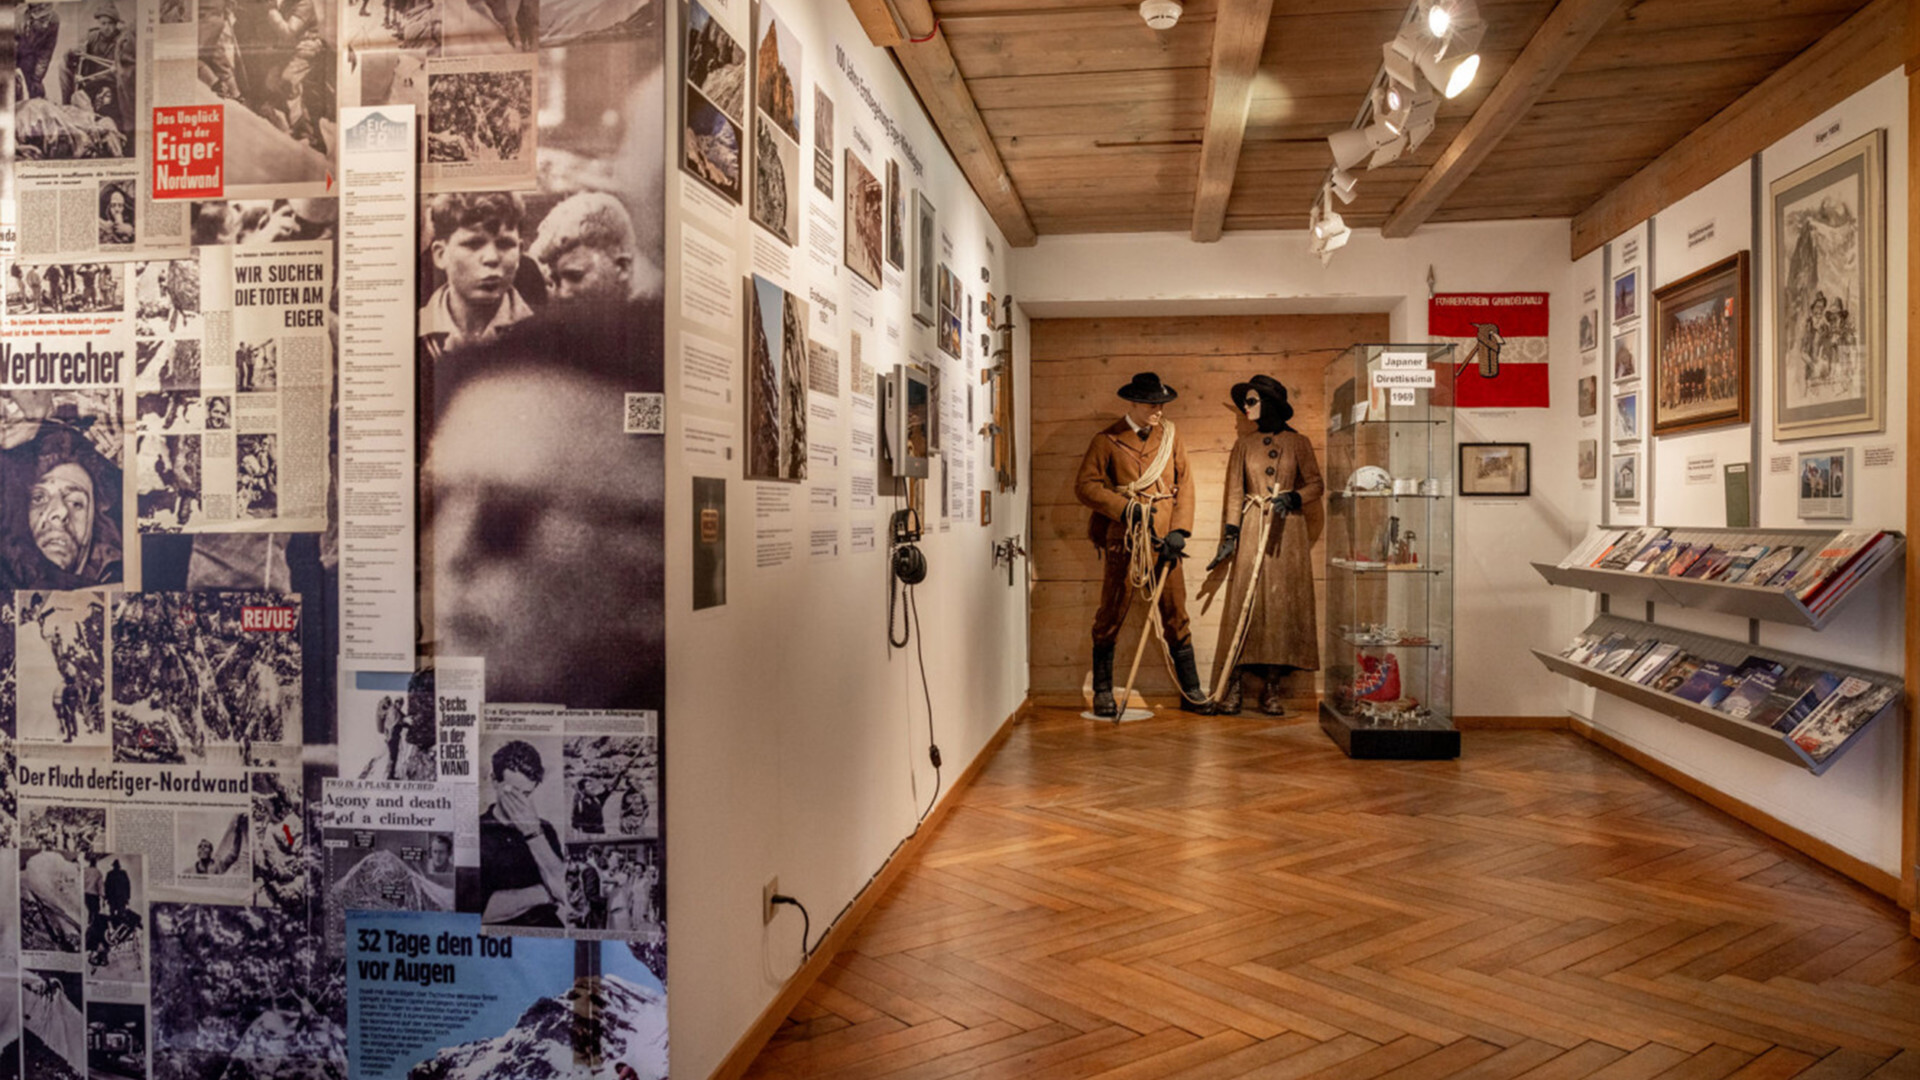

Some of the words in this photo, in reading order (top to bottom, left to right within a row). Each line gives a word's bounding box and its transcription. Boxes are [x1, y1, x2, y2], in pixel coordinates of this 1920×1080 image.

[156, 111, 175, 125] Das
[177, 109, 220, 127] Unglück
[182, 126, 193, 138] in
[194, 126, 210, 138] der
[156, 131, 220, 166] Eiger-
[156, 164, 220, 191] Nordwand
[235, 265, 262, 283] WIR
[268, 263, 324, 282] SUCHEN
[235, 288, 257, 306] DIE
[258, 287, 299, 305] TOTEN
[302, 286, 324, 304] AM
[284, 309, 324, 328] EIGER
[0, 341, 124, 385] Verbrecher
[1384, 357, 1423, 367] Japaner
[1376, 374, 1433, 383] Direttissima
[1392, 392, 1414, 401] 1969
[243, 609, 292, 629] REVUE
[438, 695, 467, 713] Sechs
[439, 712, 477, 727] Japaner
[439, 728, 448, 743] in
[449, 728, 466, 743] der
[440, 760, 470, 776] WAND
[19, 765, 46, 786] Der
[48, 764, 84, 789] Fluch
[87, 767, 110, 790] der
[111, 769, 249, 797] Eiger-Nordwand
[323, 793, 370, 810] Agony
[376, 795, 404, 808] and
[409, 795, 452, 810] death
[340, 810, 355, 824] of
[362, 814, 371, 824] a
[379, 812, 436, 827] climber
[357, 928, 382, 952] 32
[385, 929, 431, 958] Tage
[436, 931, 473, 957] den
[476, 933, 513, 958] Tod
[357, 959, 390, 981] vor
[393, 958, 456, 987] Augen
